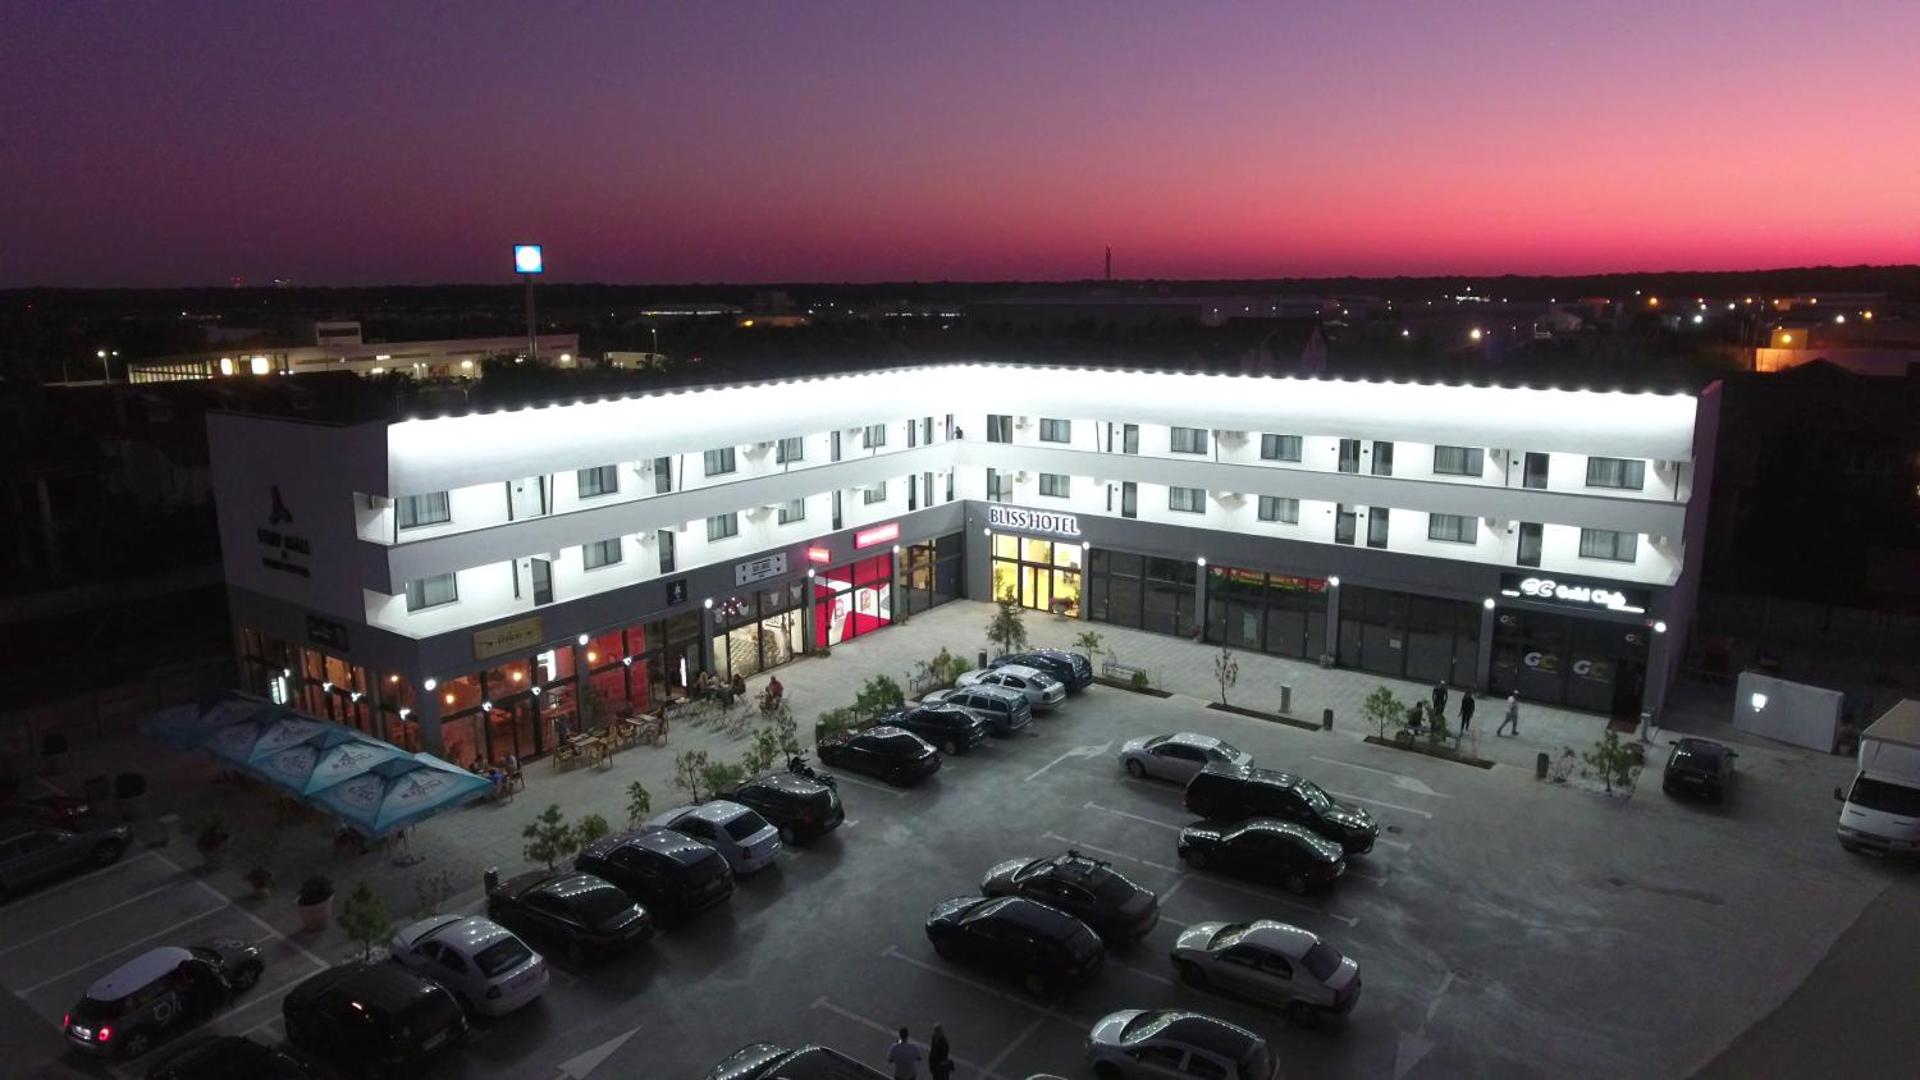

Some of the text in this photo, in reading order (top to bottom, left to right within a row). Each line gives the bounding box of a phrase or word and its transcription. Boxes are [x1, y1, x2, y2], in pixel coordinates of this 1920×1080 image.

[990, 507, 1079, 535] BLISS HOTEL
[1524, 652, 1558, 668] GC
[1573, 660, 1607, 676] GC
